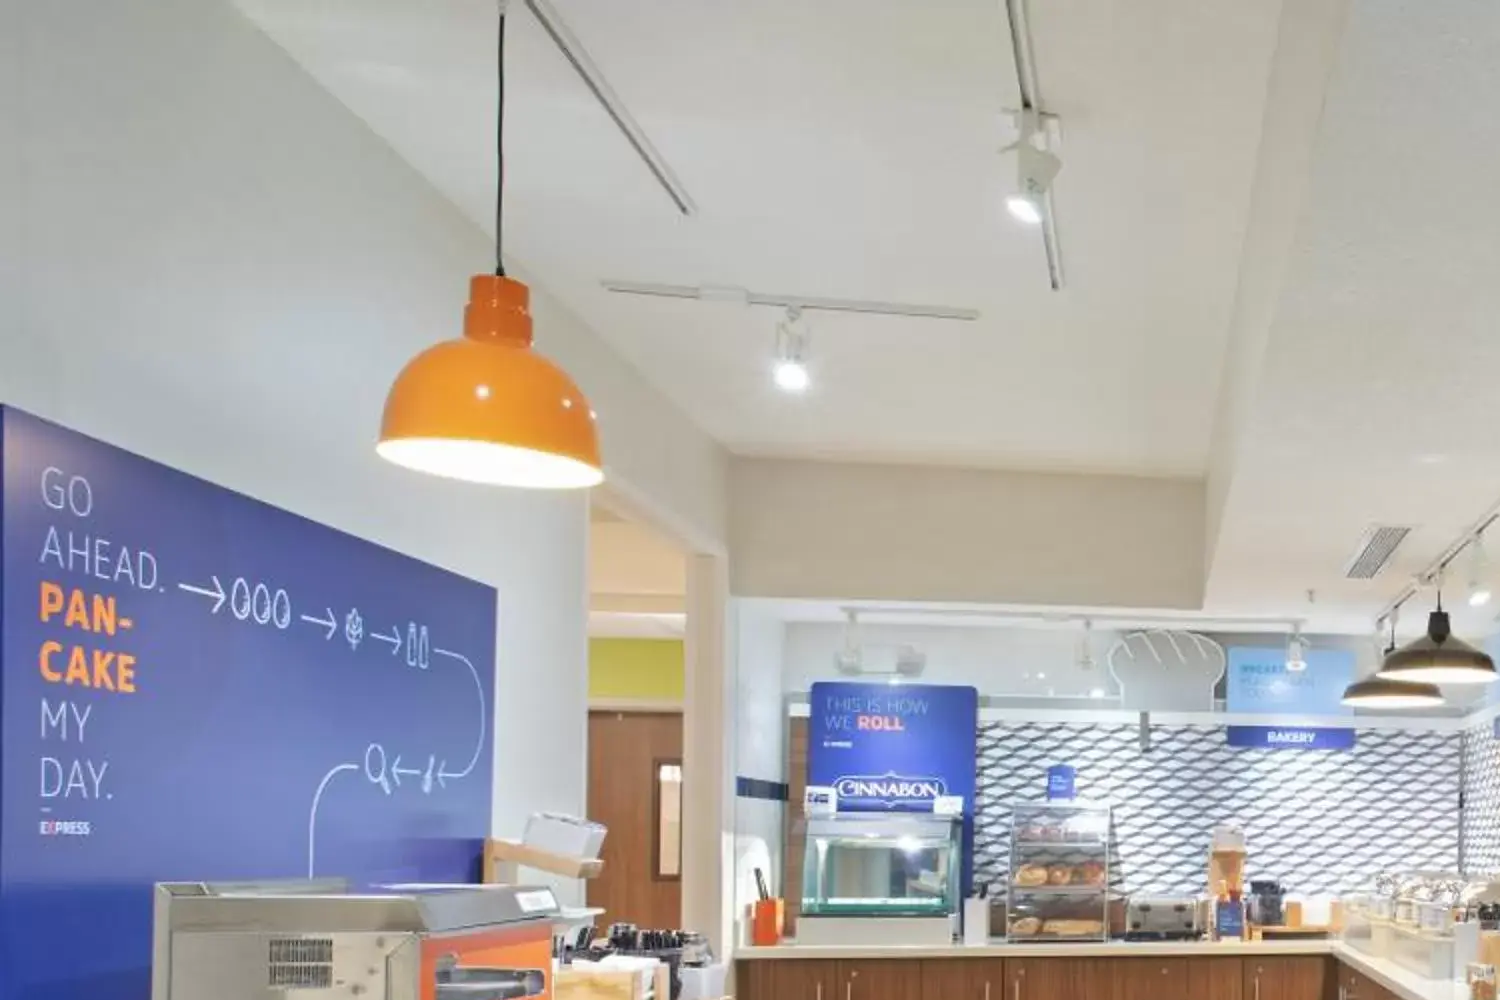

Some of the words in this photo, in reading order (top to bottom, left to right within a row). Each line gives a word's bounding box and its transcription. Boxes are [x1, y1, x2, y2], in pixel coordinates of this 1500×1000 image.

[41, 466, 93, 517] GO
[40, 525, 165, 594] AHEAD.
[39, 582, 134, 636] PAN-
[38, 641, 136, 693] CAKE
[41, 698, 92, 743] MY
[825, 715, 852, 731] WE
[857, 714, 905, 731] ROLL
[826, 696, 861, 713] THIS
[867, 698, 881, 713] IS
[887, 699, 929, 715] HOW
[1267, 731, 1316, 743] BAKERY
[40, 756, 113, 800] DAY.
[838, 779, 940, 798] CINNABON
[40, 821, 90, 836] EXPRESS
